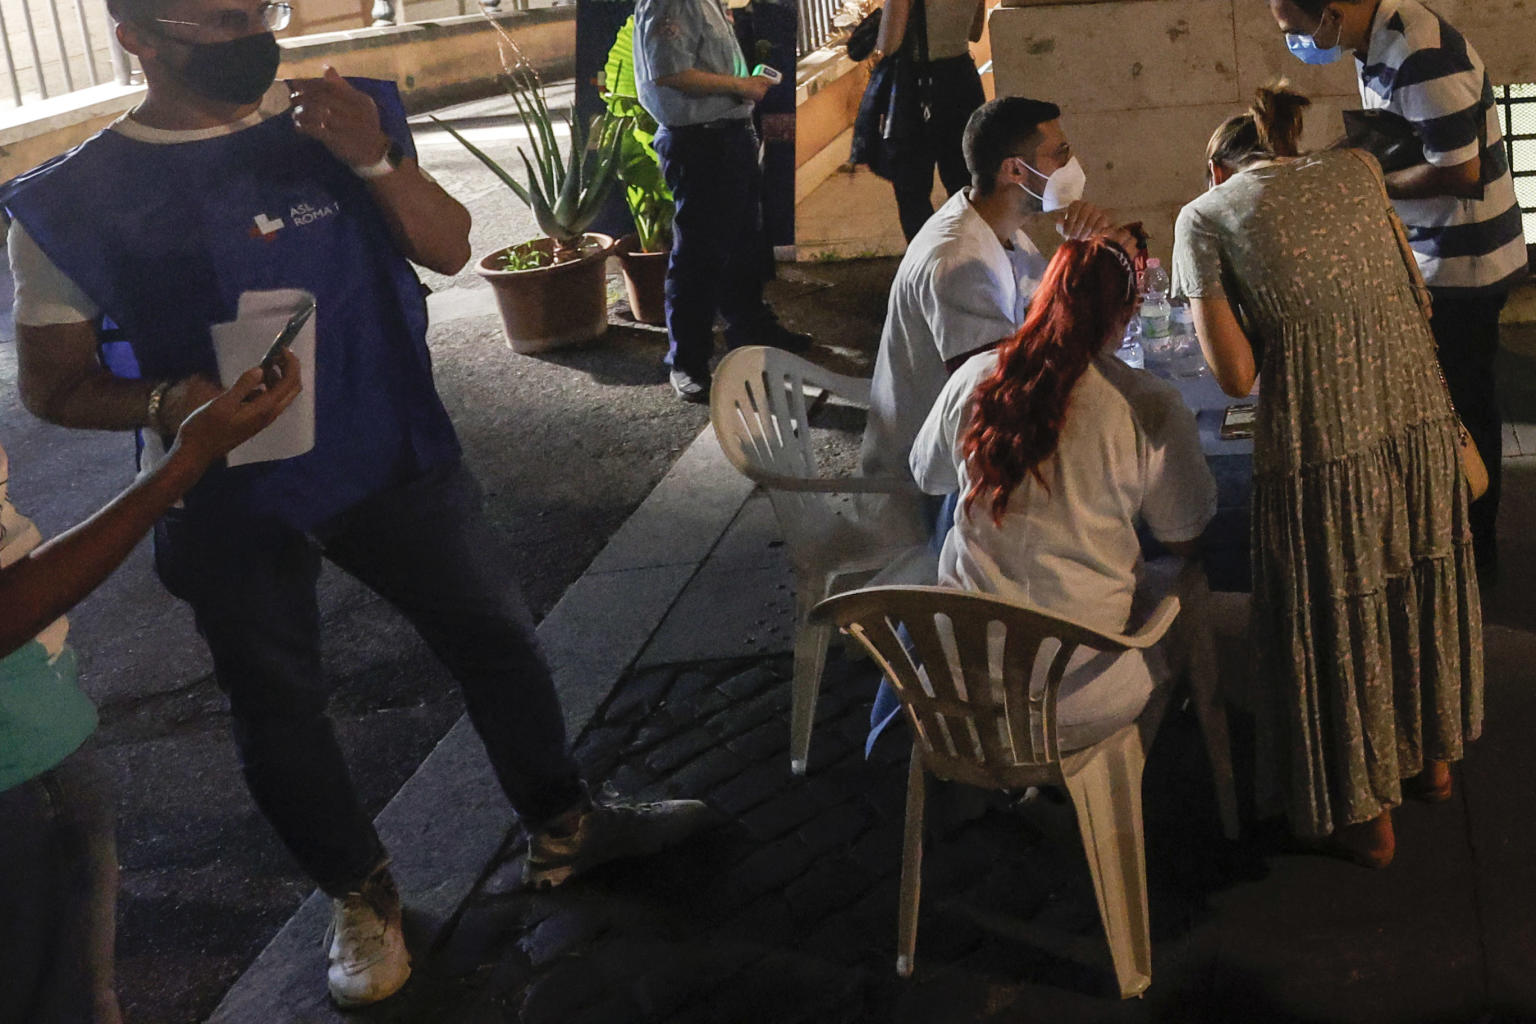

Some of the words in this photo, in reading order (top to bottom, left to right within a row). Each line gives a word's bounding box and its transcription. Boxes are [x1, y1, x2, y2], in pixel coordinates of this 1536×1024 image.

[290, 203, 315, 218] ASL
[293, 207, 333, 226] ROMA
[333, 201, 341, 211] 1
